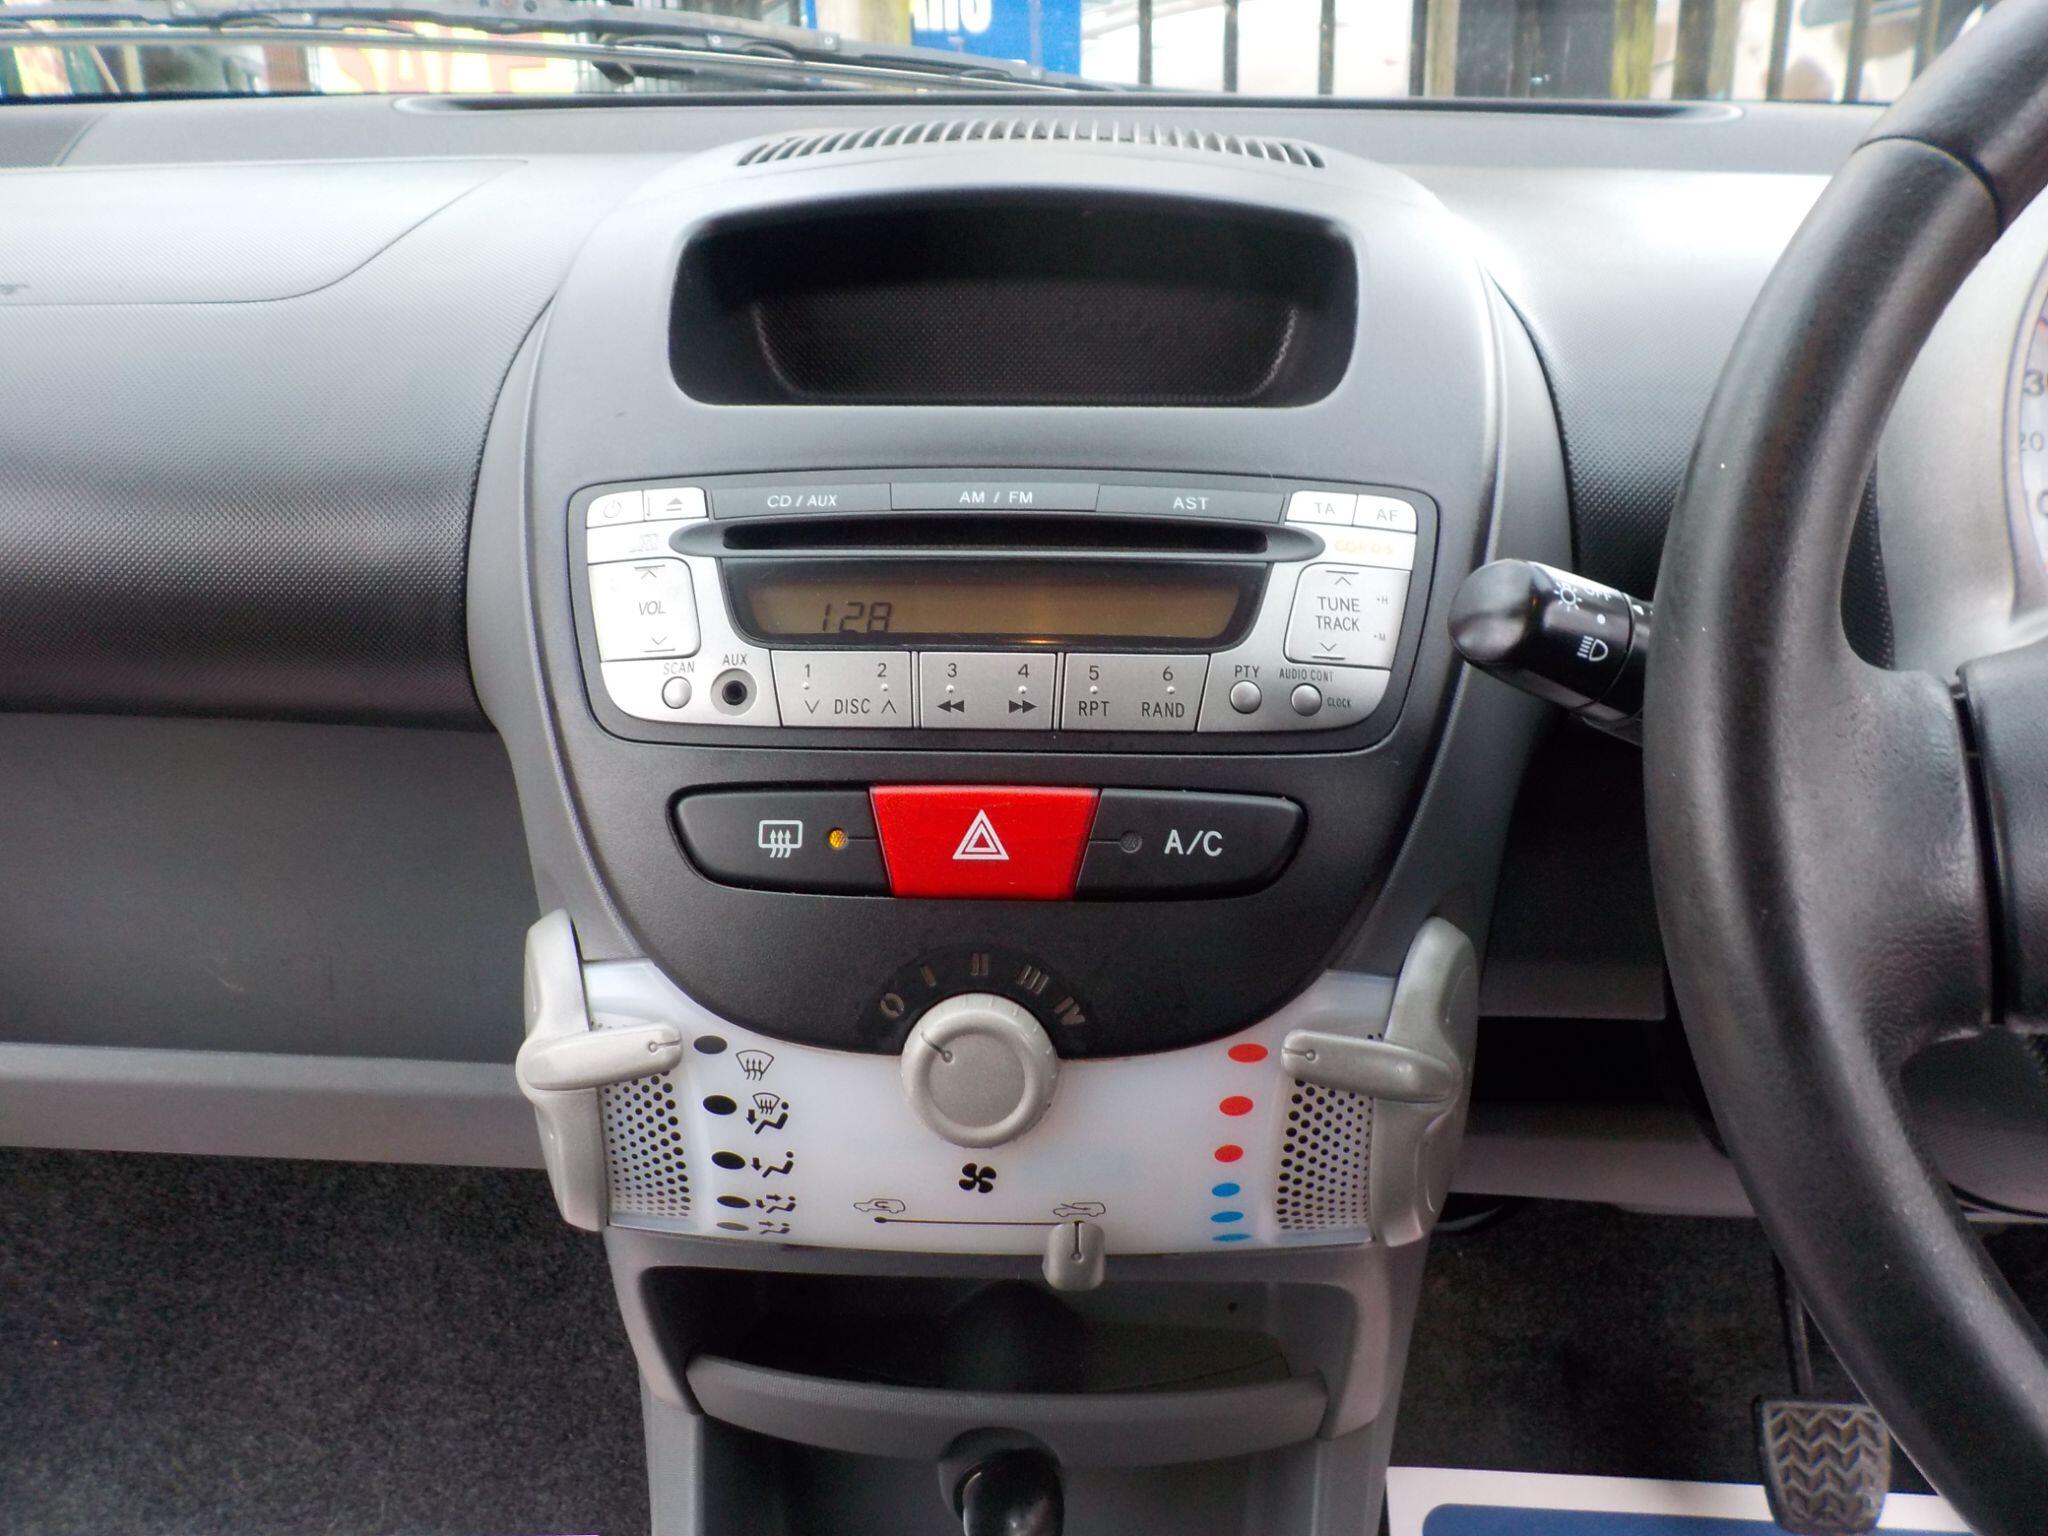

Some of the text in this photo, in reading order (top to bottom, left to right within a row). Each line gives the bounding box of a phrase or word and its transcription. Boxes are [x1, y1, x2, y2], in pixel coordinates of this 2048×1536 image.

[766, 494, 795, 508] CD
[807, 494, 838, 507] AUX
[959, 491, 985, 504] AM
[1008, 490, 1033, 504] FM
[1172, 497, 1209, 511] AST
[1314, 501, 1336, 515] TA
[1376, 508, 1399, 522] AF
[638, 601, 667, 615] VOL
[1316, 595, 1361, 613] TUNE
[1315, 615, 1360, 632] TRACK
[722, 653, 748, 667] AUX
[663, 661, 695, 675] SCAN
[803, 664, 811, 678] 1
[876, 662, 887, 678] 2
[947, 662, 958, 678] 3
[1017, 663, 1030, 678] 4
[1088, 665, 1100, 681] 5
[1162, 665, 1174, 681] 6
[1234, 664, 1260, 678] PTY
[1279, 668, 1334, 682] AUDIO CONT
[833, 698, 871, 714] DISC
[1078, 701, 1110, 717] RPT
[1141, 701, 1186, 718] RAND
[1326, 696, 1352, 709] CLOCK
[1163, 830, 1223, 858] A/C
